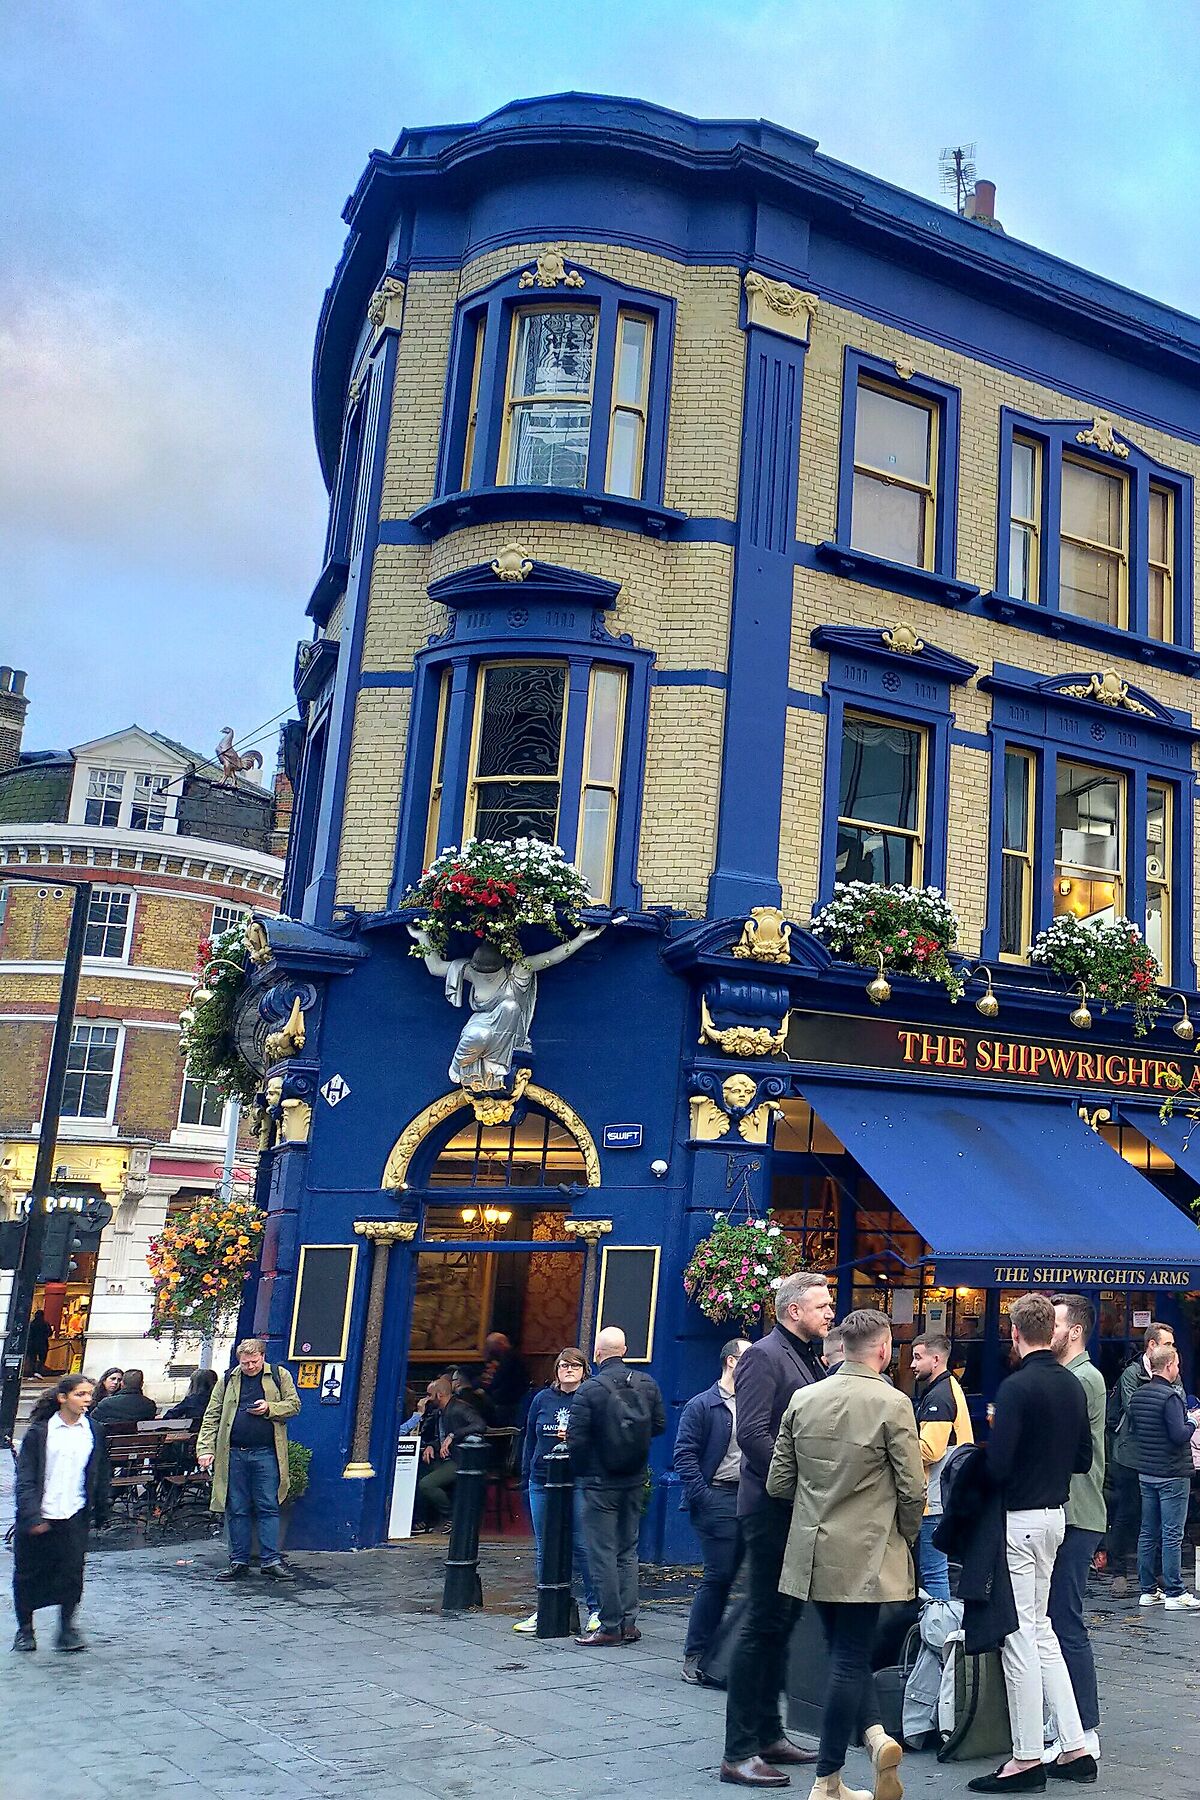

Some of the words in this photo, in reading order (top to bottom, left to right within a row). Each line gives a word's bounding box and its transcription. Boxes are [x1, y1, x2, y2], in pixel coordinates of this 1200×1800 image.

[898, 1030, 968, 1067] THE
[975, 1039, 1181, 1091] SHIPWRIGHTS
[607, 1131, 640, 1140] SWIFT
[994, 1267, 1030, 1282] THE
[1032, 1268, 1146, 1285] SHIPWRIGHTS
[1148, 1271, 1190, 1285] ARMS
